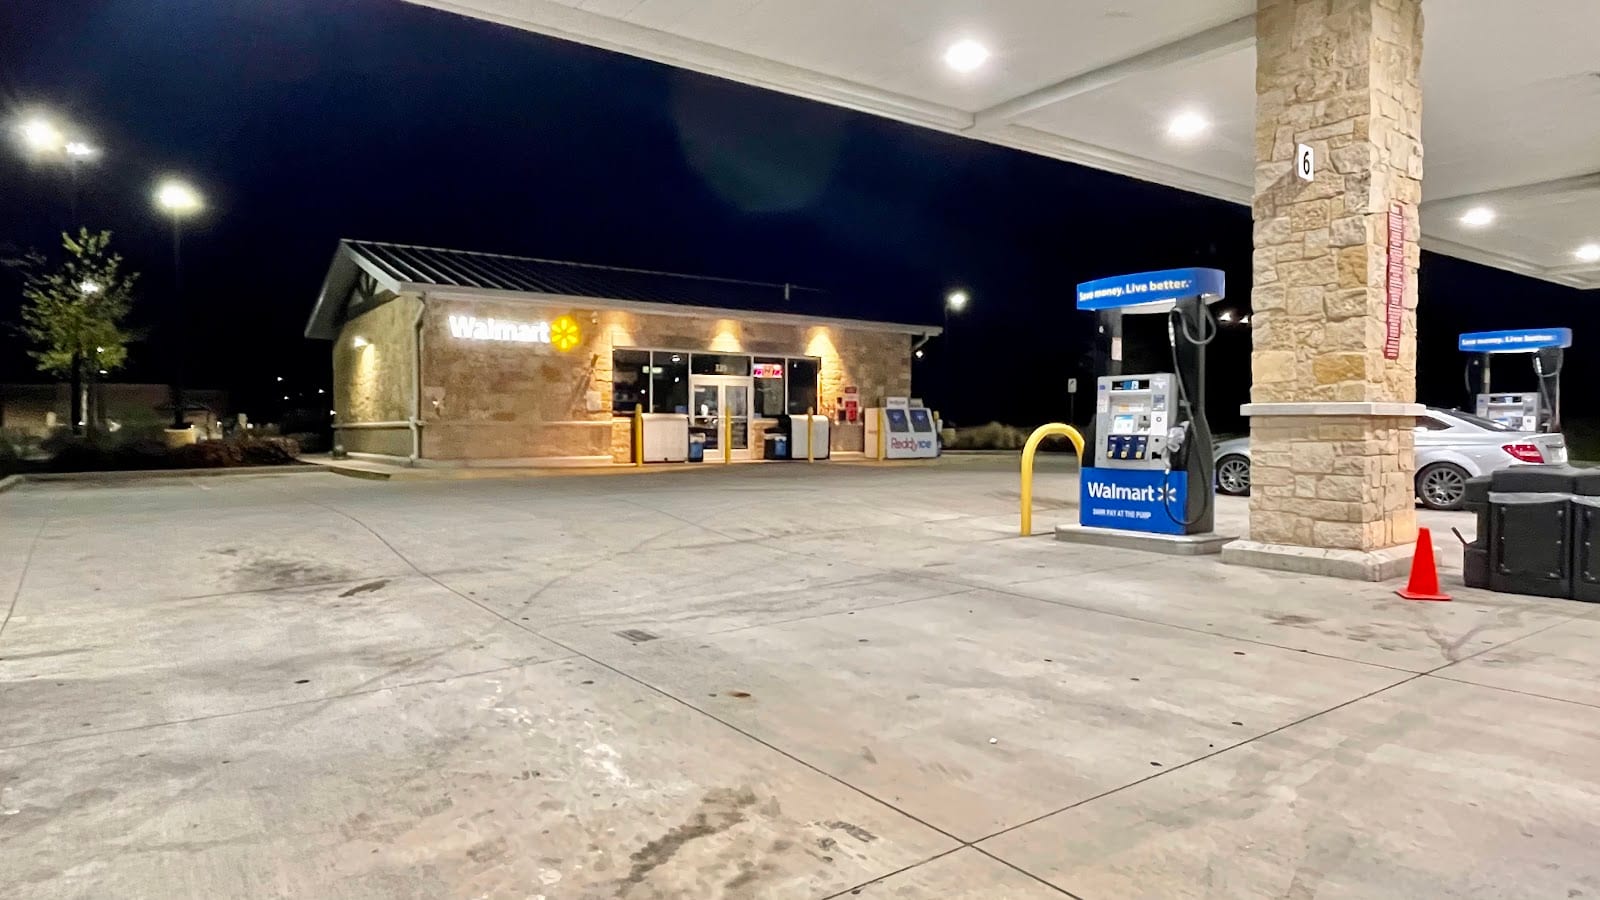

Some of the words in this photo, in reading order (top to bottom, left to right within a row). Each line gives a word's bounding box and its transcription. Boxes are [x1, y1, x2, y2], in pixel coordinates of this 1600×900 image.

[1303, 151, 1310, 175] 6
[1126, 282, 1147, 295] Live
[449, 315, 550, 344] Walmart
[1087, 481, 1155, 502] Walmart
[1106, 509, 1117, 517] PAY
[1117, 509, 1124, 518] AT
